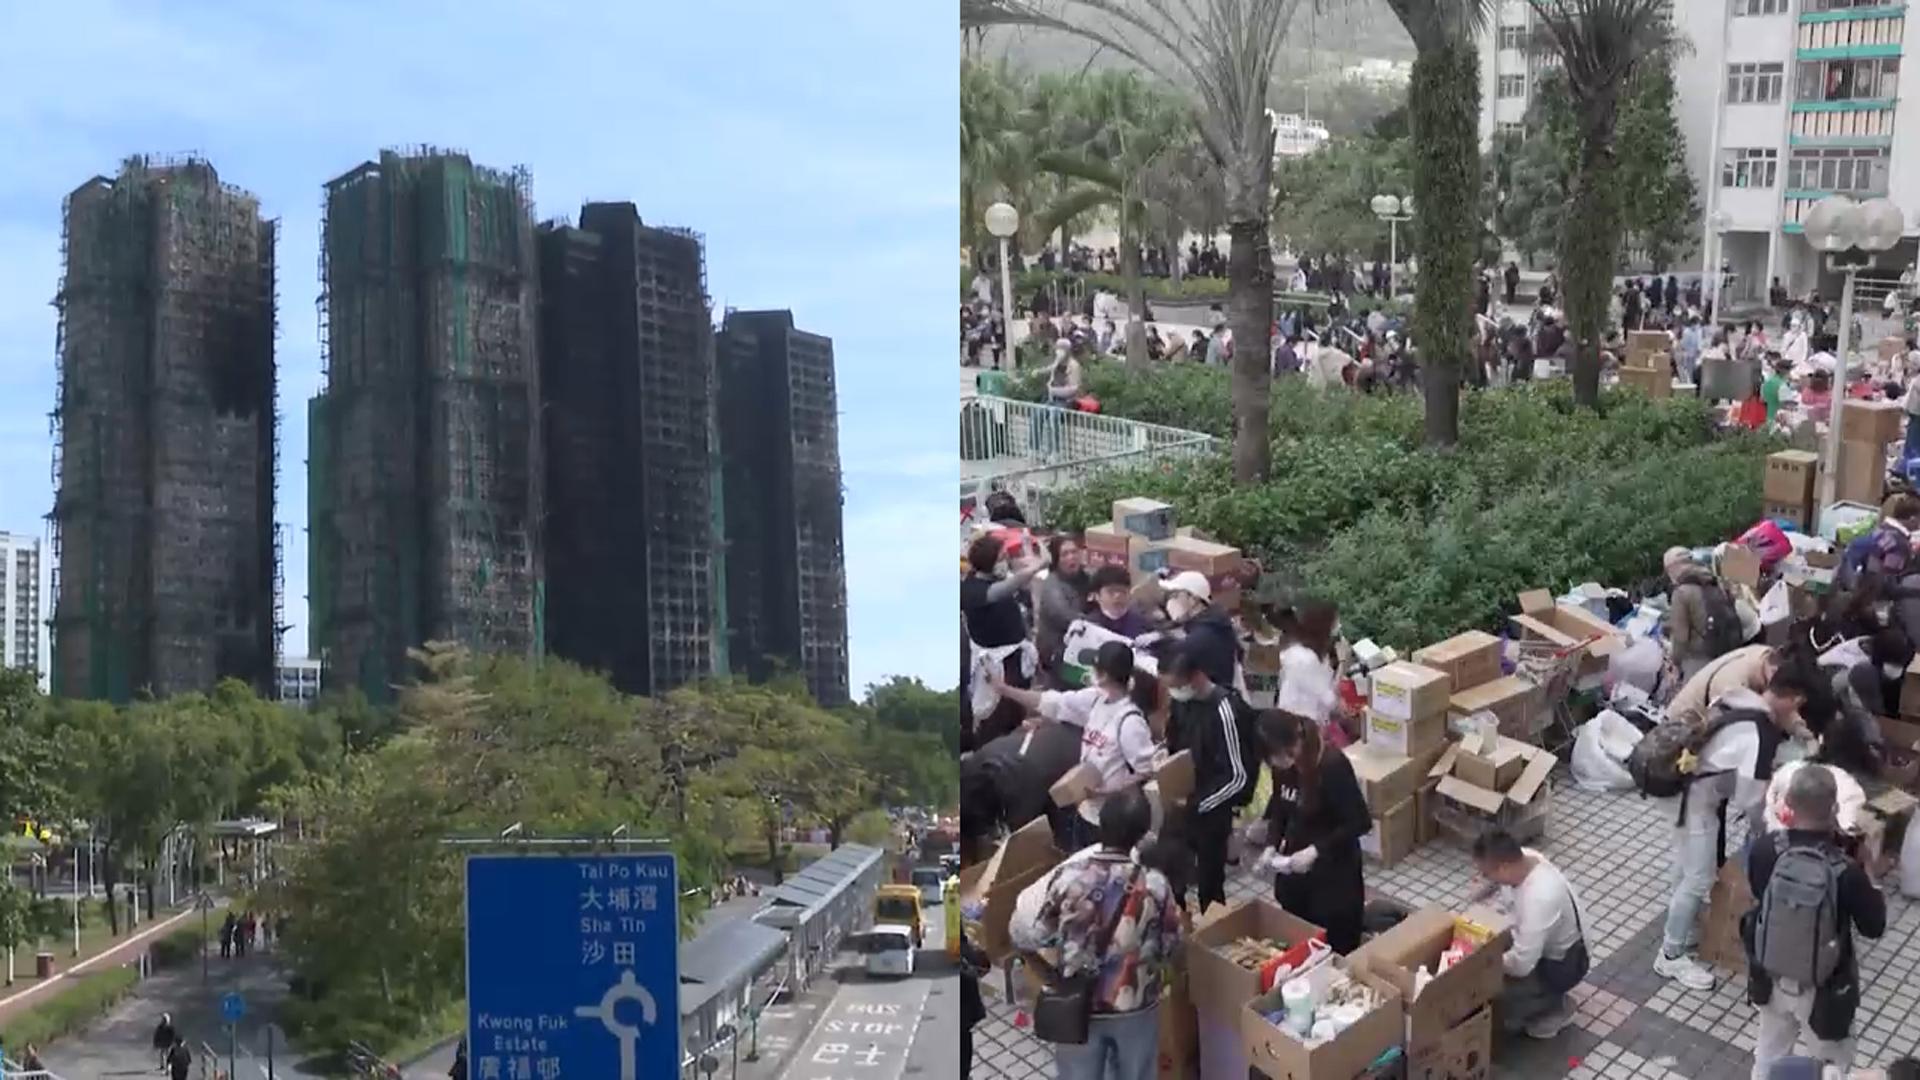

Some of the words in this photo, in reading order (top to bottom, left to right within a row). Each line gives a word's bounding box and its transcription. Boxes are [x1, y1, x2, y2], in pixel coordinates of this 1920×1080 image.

[579, 863, 603, 878] Tai
[609, 863, 630, 878] Po
[636, 862, 668, 878] Kau
[581, 917, 611, 933] Sha
[620, 917, 646, 933] Tin
[582, 939, 635, 965] 沙田
[478, 1013, 533, 1032] Kwong
[538, 1014, 568, 1029] Fuk
[824, 1019, 903, 1034] STOP
[494, 1035, 547, 1052] Estate
[812, 1041, 886, 1066] 巴士
[479, 1056, 560, 1080] 廣福邨
